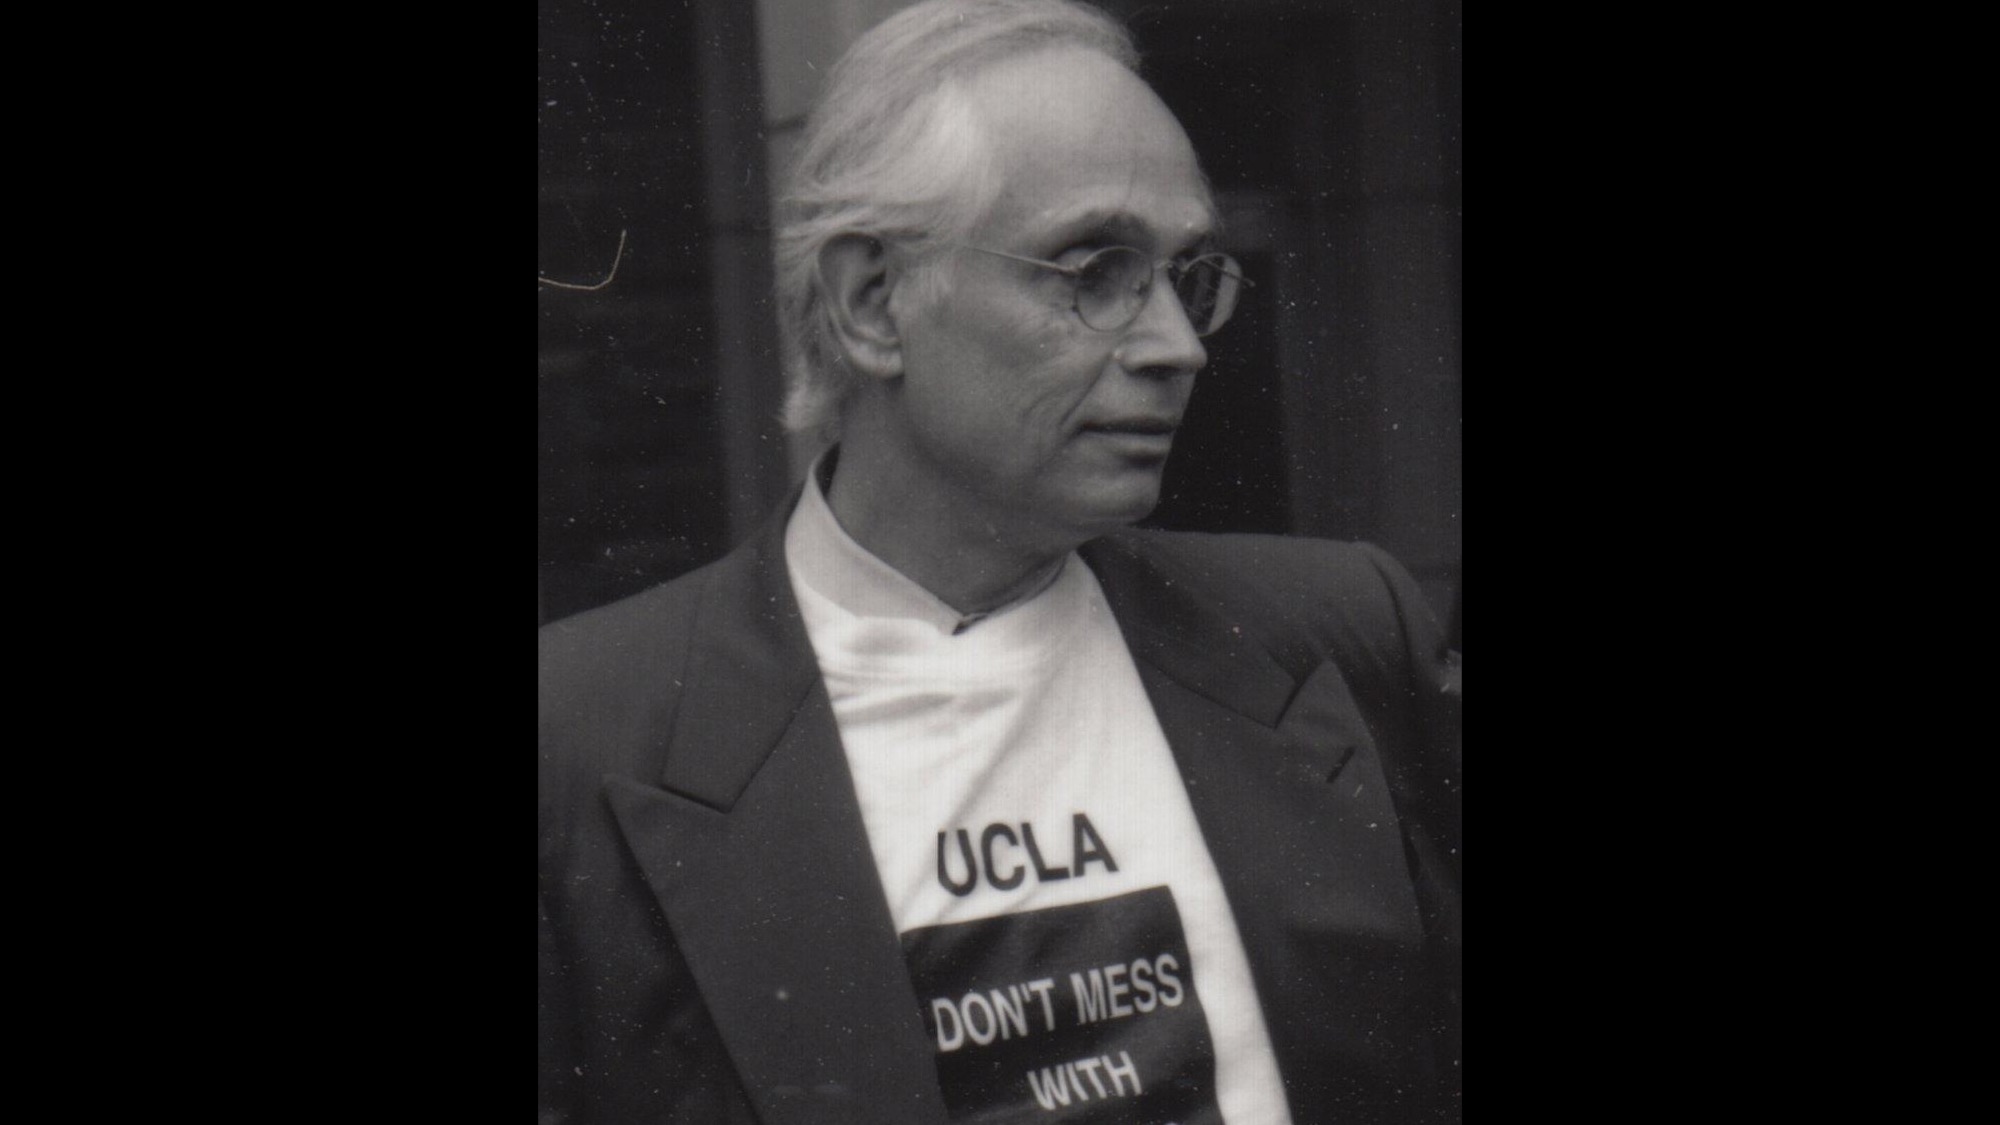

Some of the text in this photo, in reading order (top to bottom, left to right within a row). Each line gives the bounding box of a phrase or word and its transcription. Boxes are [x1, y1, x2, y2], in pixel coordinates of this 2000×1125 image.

[937, 813, 1119, 897] UCLA
[932, 953, 1184, 1052] DON'T MESS
[1027, 1051, 1142, 1110] WITH
